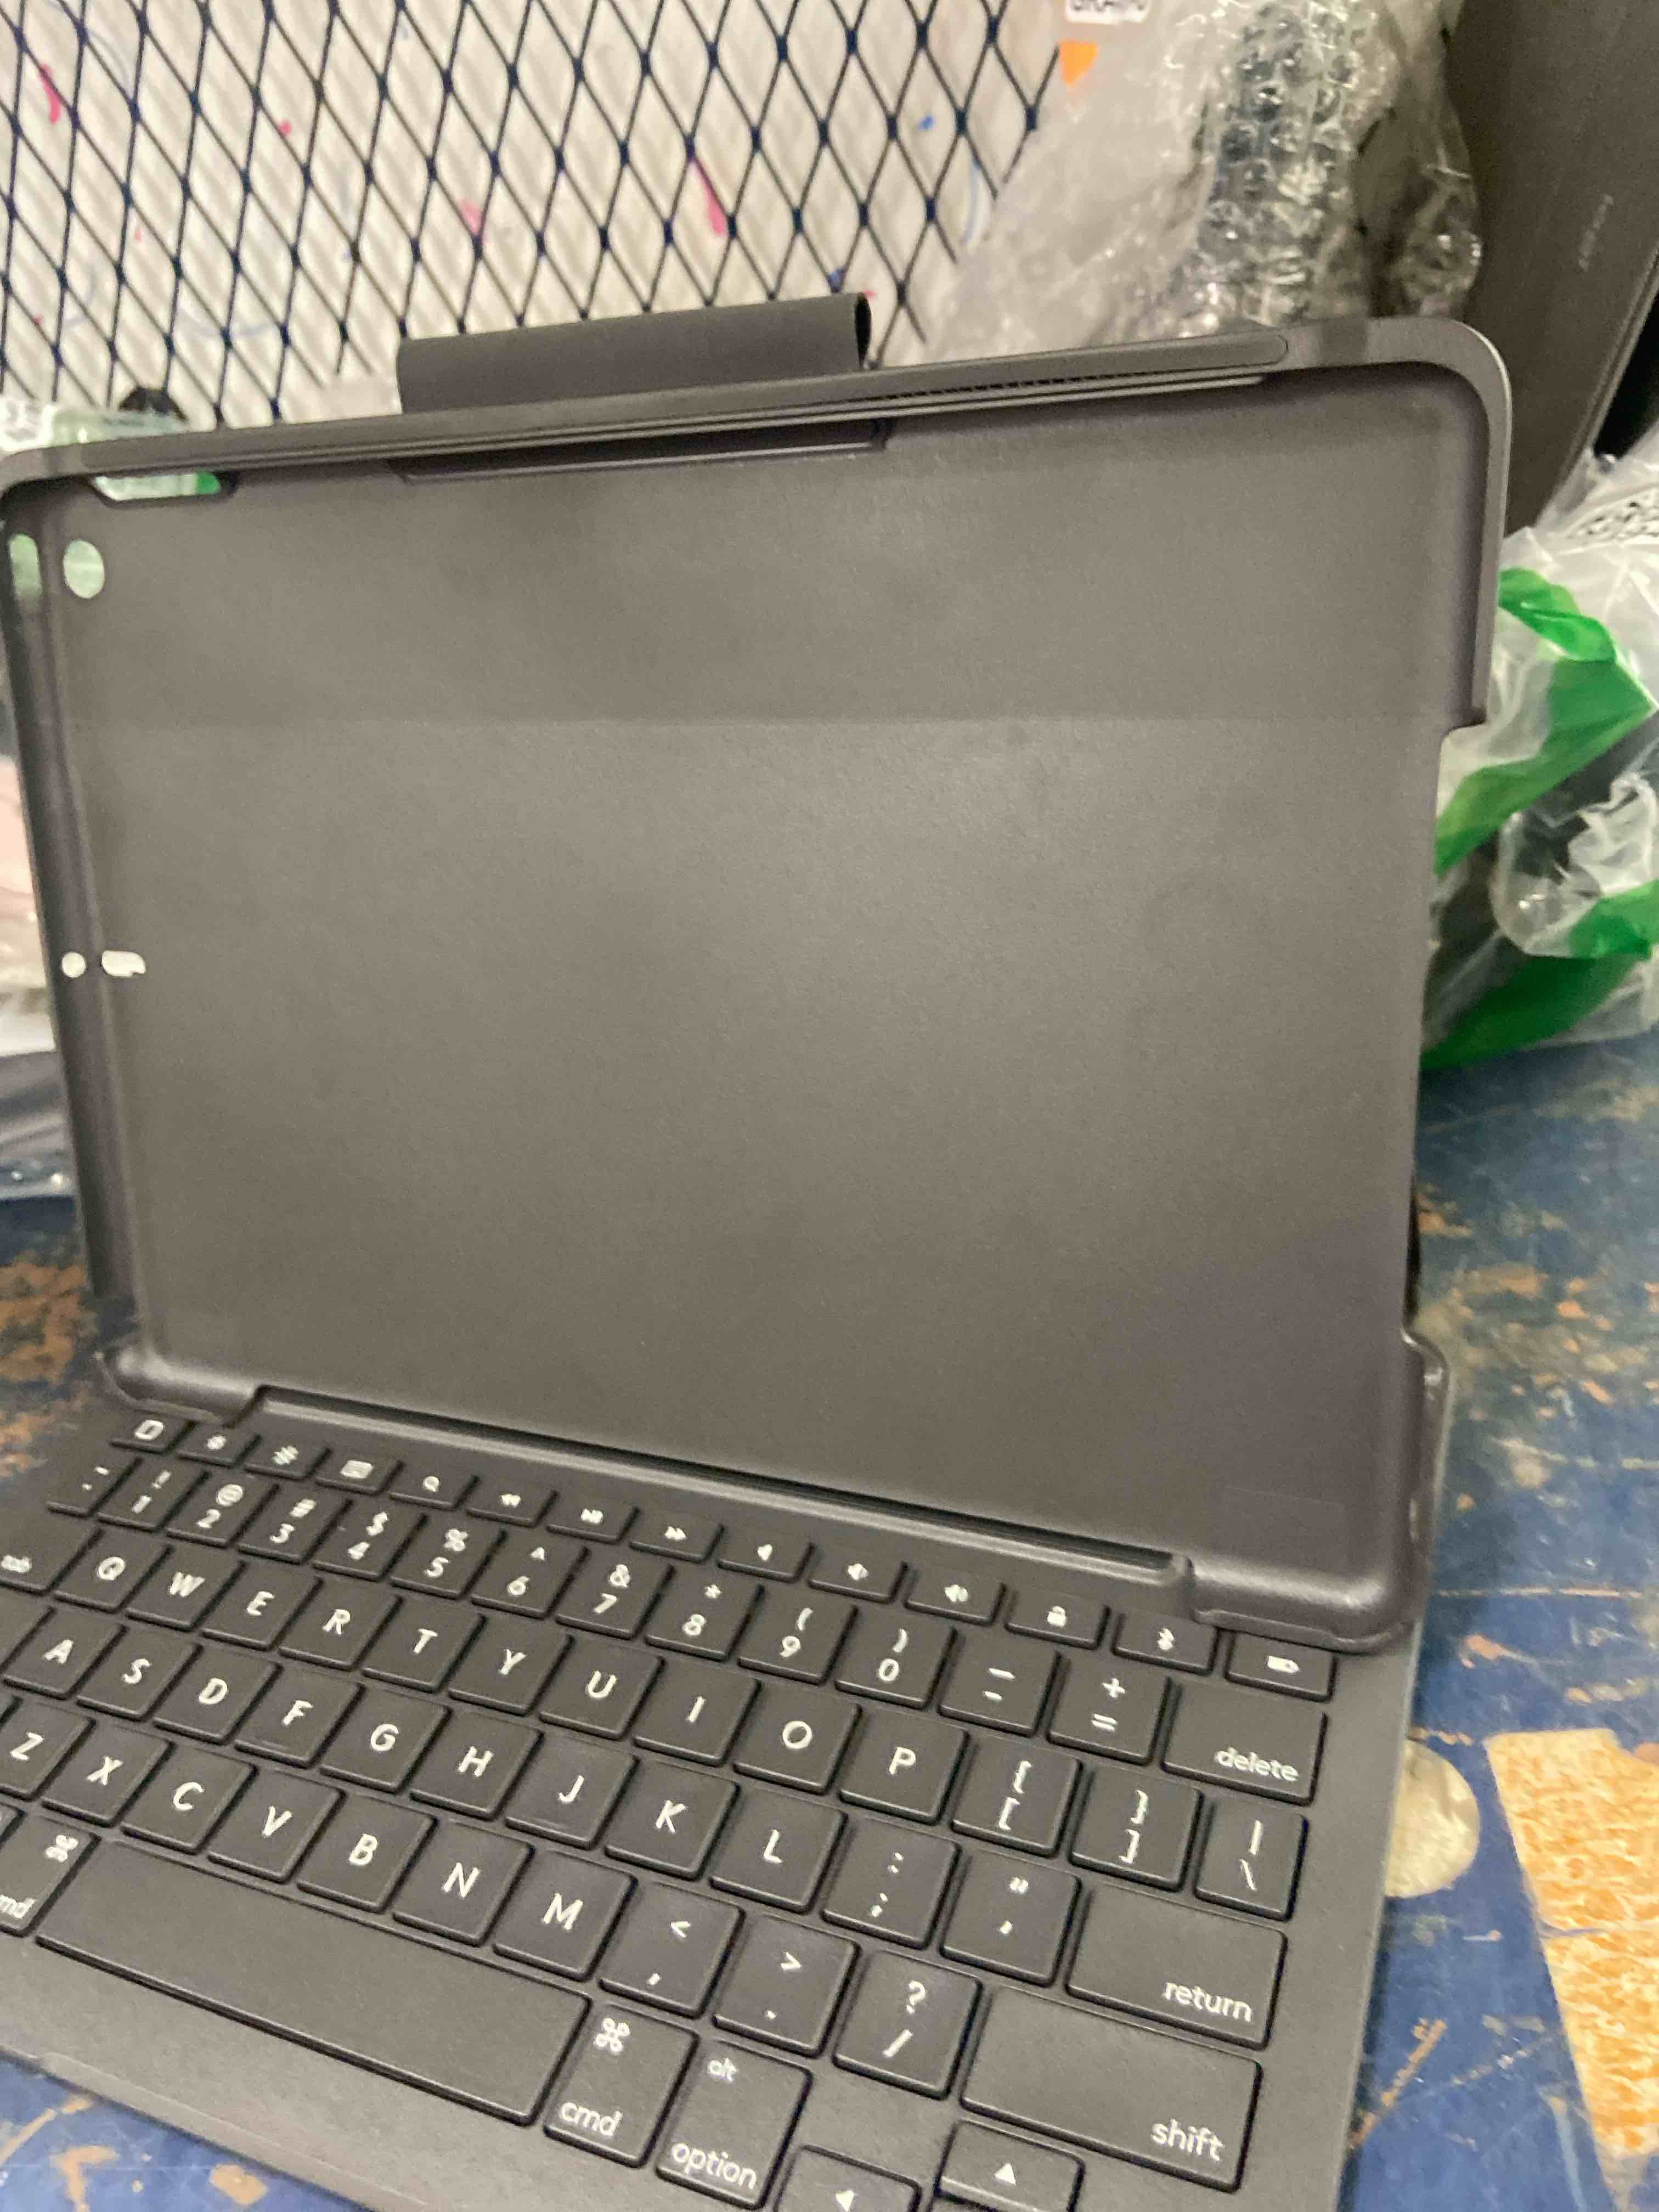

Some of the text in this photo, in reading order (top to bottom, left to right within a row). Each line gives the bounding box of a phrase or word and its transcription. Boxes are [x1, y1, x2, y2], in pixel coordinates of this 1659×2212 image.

[152, 1470, 172, 1489] !
[216, 1483, 244, 1507] @
[196, 1509, 221, 1529] 2
[365, 1511, 390, 1537] $
[269, 1523, 295, 1544] 3
[443, 1528, 469, 1552] %
[347, 1541, 371, 1560] 4
[96, 1556, 126, 1581] Q
[424, 1556, 449, 1579] 5
[607, 1564, 631, 1589] &
[167, 1571, 205, 1598] W
[507, 1575, 530, 1598] 6
[245, 1590, 275, 1616] E
[594, 1593, 618, 1615] 7
[321, 1609, 351, 1635] R
[681, 1613, 707, 1638] 8
[795, 1607, 814, 1632] (
[43, 1639, 74, 1664] A
[413, 1628, 438, 1655] T
[779, 1635, 802, 1658] 9
[892, 1628, 909, 1653] )
[121, 1658, 152, 1685] S
[498, 1649, 527, 1676] Y
[198, 1677, 229, 1705] D
[585, 1670, 618, 1700] U
[1101, 1678, 1126, 1699] +
[281, 1700, 314, 1726] F
[1091, 1713, 1118, 1732] =
[9, 1731, 45, 1761] Z
[370, 1723, 399, 1752] G
[782, 1720, 813, 1750] O
[86, 1755, 123, 1787] X
[456, 1746, 494, 1778] H
[888, 1746, 917, 1775] P
[1214, 1746, 1299, 1782] delete
[172, 1781, 205, 1812] C
[557, 1775, 585, 1804] J
[655, 1799, 687, 1835] K
[996, 1796, 1020, 1831] [
[1130, 1789, 1149, 1825] }
[261, 1805, 292, 1838] V
[347, 1833, 378, 1867] B
[763, 1829, 783, 1864] L
[1119, 1829, 1141, 1865] ]
[887, 1852, 905, 1874] :
[441, 1862, 481, 1898] N
[1009, 1876, 1029, 1895] "
[0, 1894, 37, 1920] md
[540, 1892, 583, 1931] M
[870, 1892, 888, 1918] ;
[670, 1921, 692, 1939] <
[781, 1951, 802, 1972] >
[905, 1980, 927, 2015] ?
[1162, 1982, 1252, 2023] return
[882, 2029, 913, 2058] /
[558, 2101, 624, 2138] cmd
[1150, 2118, 1225, 2162] shift
[671, 2143, 757, 2191] option
